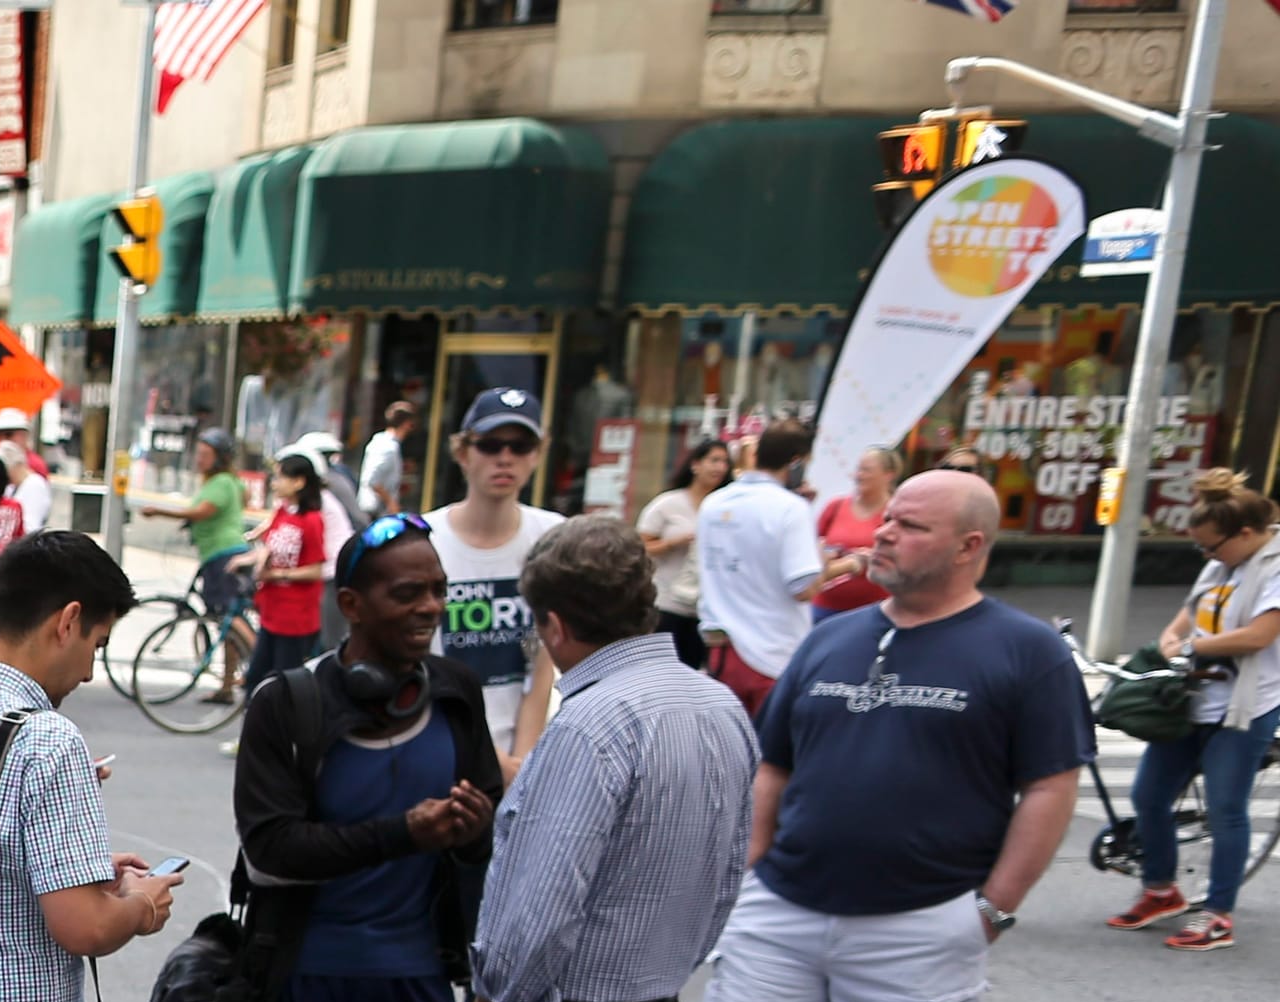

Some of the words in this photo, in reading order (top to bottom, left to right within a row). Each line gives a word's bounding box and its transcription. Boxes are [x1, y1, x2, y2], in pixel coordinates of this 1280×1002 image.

[966, 396, 1077, 430] ENTIRE
[1087, 396, 1189, 427] STE
[1037, 462, 1101, 498] OFF
[445, 582, 495, 602] JOHN
[480, 628, 535, 646] MAYO
